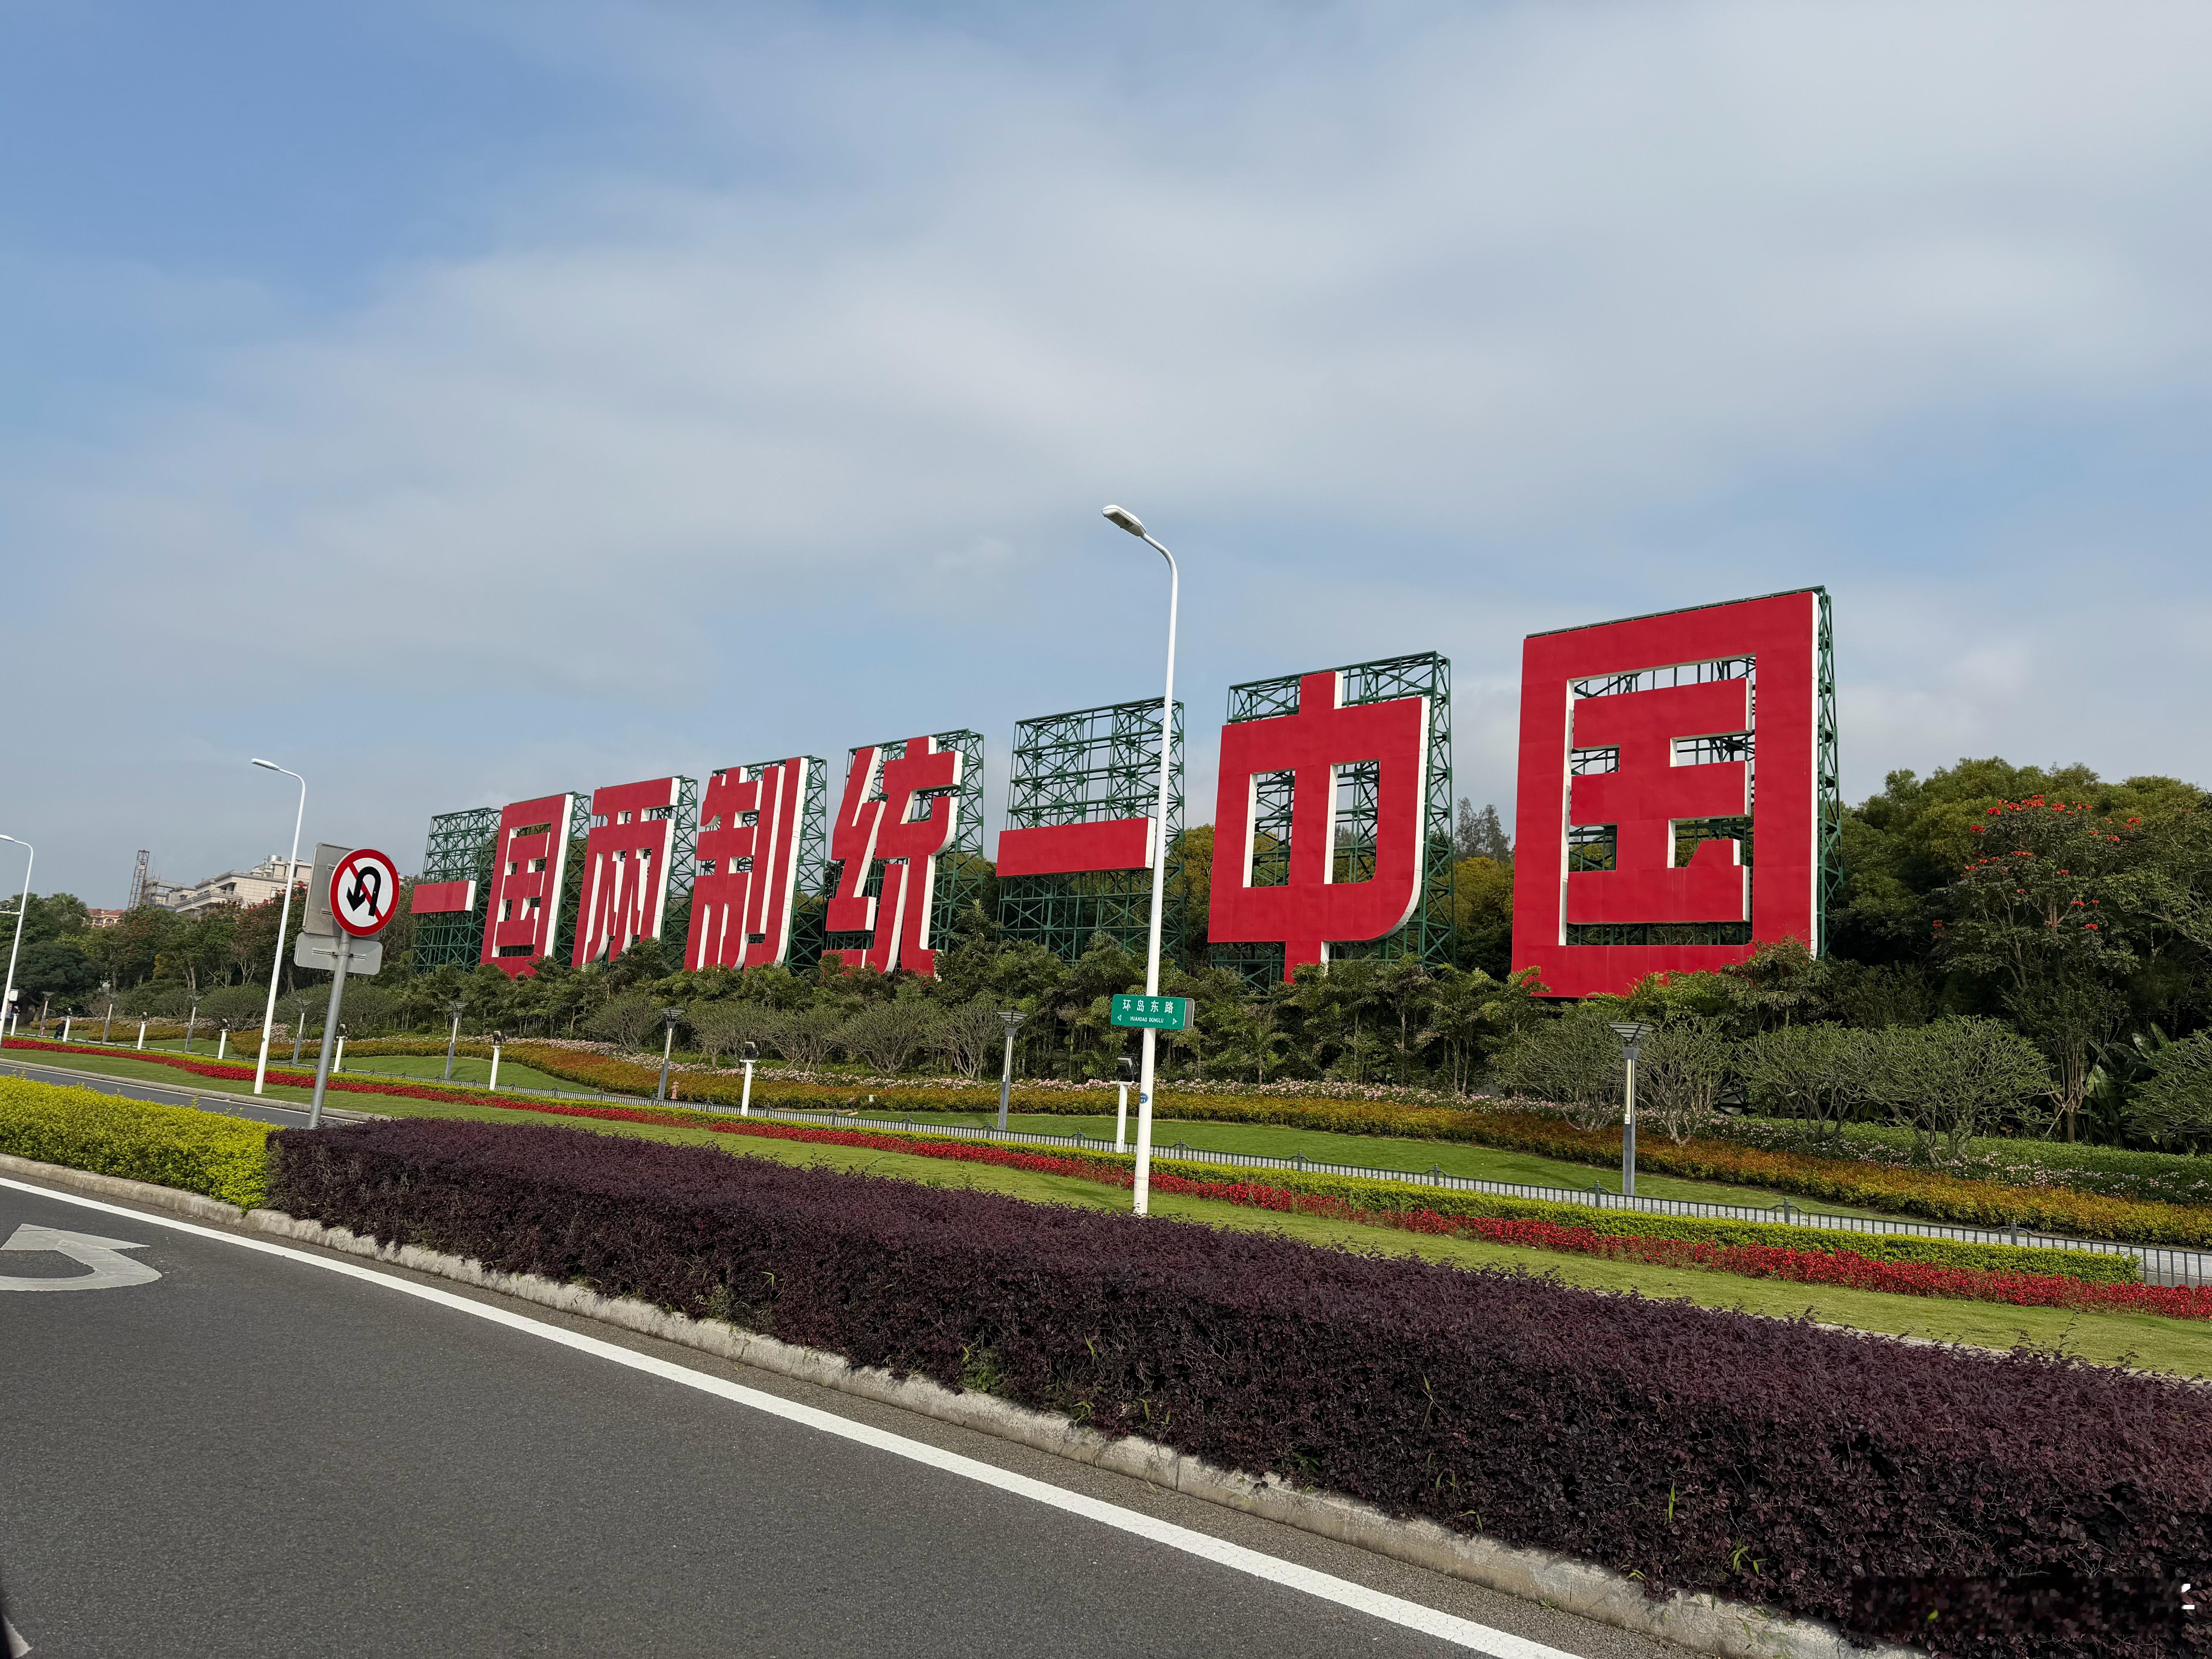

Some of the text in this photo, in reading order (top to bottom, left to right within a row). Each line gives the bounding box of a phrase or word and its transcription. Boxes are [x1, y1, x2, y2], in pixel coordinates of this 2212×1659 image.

[411, 591, 1818, 998] 一国两制统一中国
[1123, 999, 1173, 1013] 环岛东路
